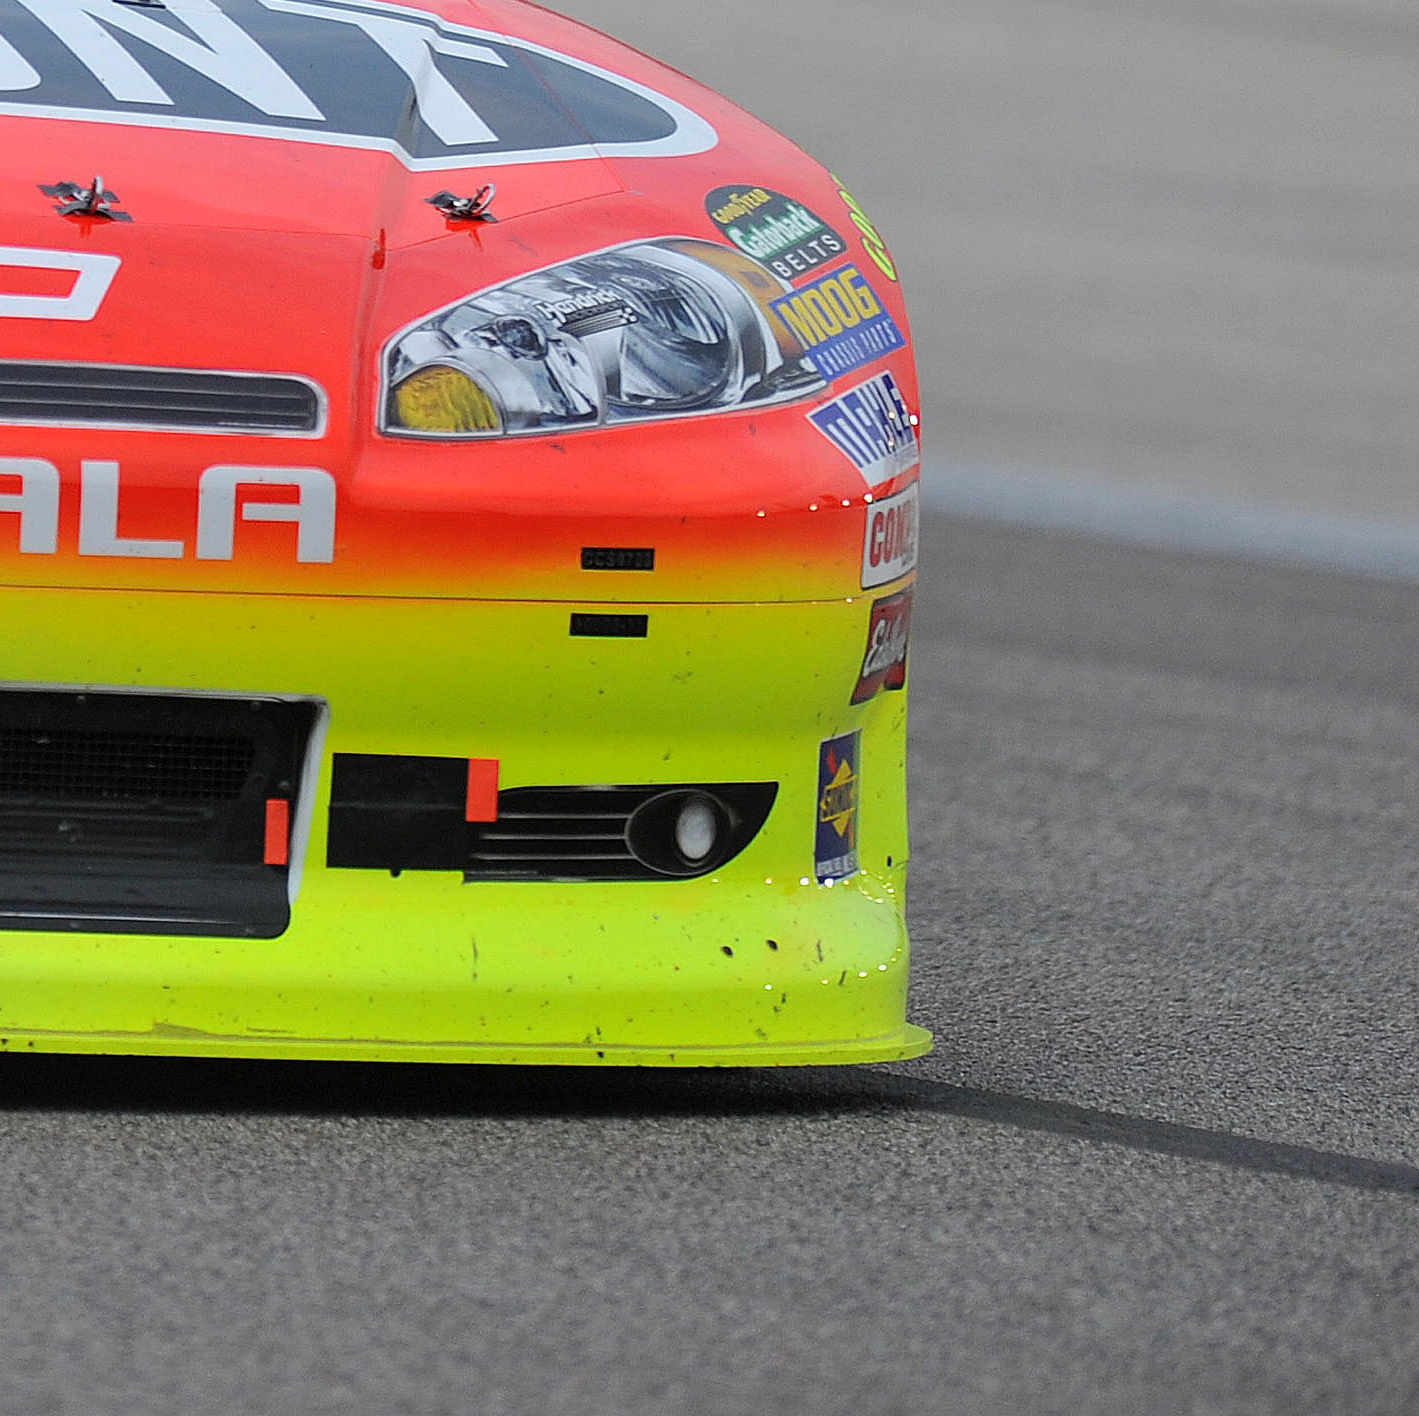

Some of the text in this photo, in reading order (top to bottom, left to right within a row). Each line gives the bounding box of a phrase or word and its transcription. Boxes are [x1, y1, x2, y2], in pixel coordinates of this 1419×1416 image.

[726, 201, 823, 259] Gatorback
[771, 234, 842, 278] BELTS
[535, 288, 623, 323] Hendrick
[776, 267, 881, 351] MOOG
